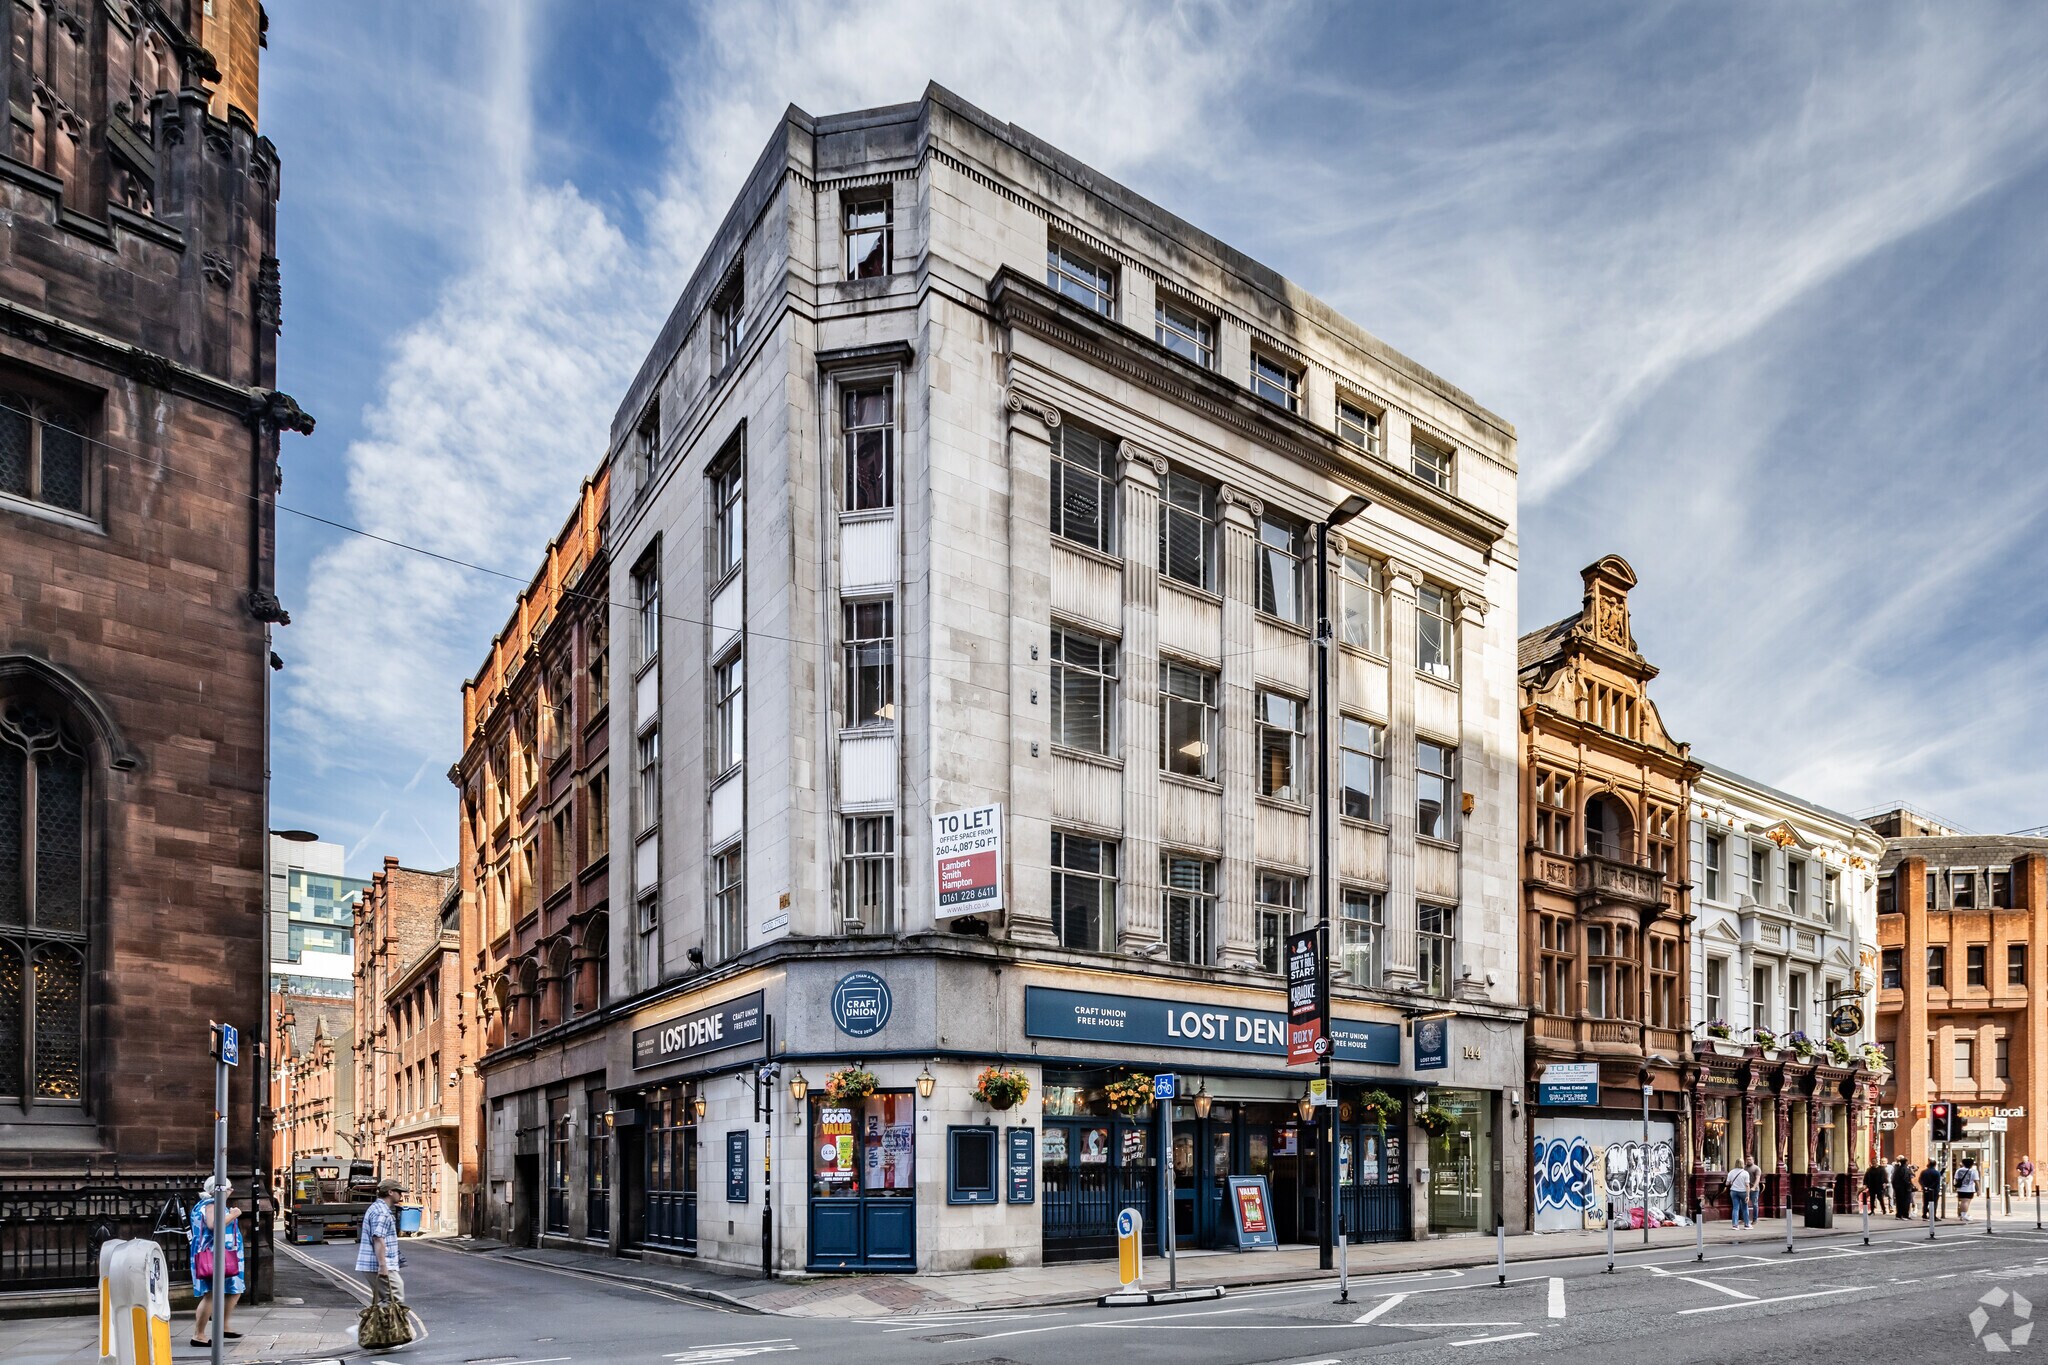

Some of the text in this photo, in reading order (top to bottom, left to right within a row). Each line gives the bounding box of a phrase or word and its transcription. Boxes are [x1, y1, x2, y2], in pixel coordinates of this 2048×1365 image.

[939, 808, 993, 834] TO LET
[940, 828, 994, 843] OFFICE SPACE FROM
[936, 837, 998, 856] 260-4,087 SQ FT
[941, 859, 971, 871] Lambert
[941, 870, 962, 881] Smith
[942, 877, 973, 889] Hampton
[942, 887, 994, 903] 0161 228 6411
[946, 901, 991, 914] www.lsh.co.uk
[1290, 967, 1315, 980] STAR?
[847, 1000, 876, 1008] CRAFT
[732, 1007, 759, 1021] CRAFT UNION
[846, 1008, 877, 1016] UNION
[1074, 1006, 1127, 1018] CRAFT UNION
[733, 1018, 757, 1030] FREE HOUSE
[1077, 1016, 1124, 1028] FREE HOUSE
[1167, 1009, 1288, 1046] LOST DEN
[660, 1012, 724, 1055] LOST DENE
[1293, 1028, 1314, 1044] ROXY
[1315, 1041, 1326, 1050] 20
[1463, 1045, 1481, 1060] 144
[1994, 1105, 2025, 1117] Local
[822, 1113, 852, 1123] GOOD
[822, 1123, 851, 1134] VALUE
